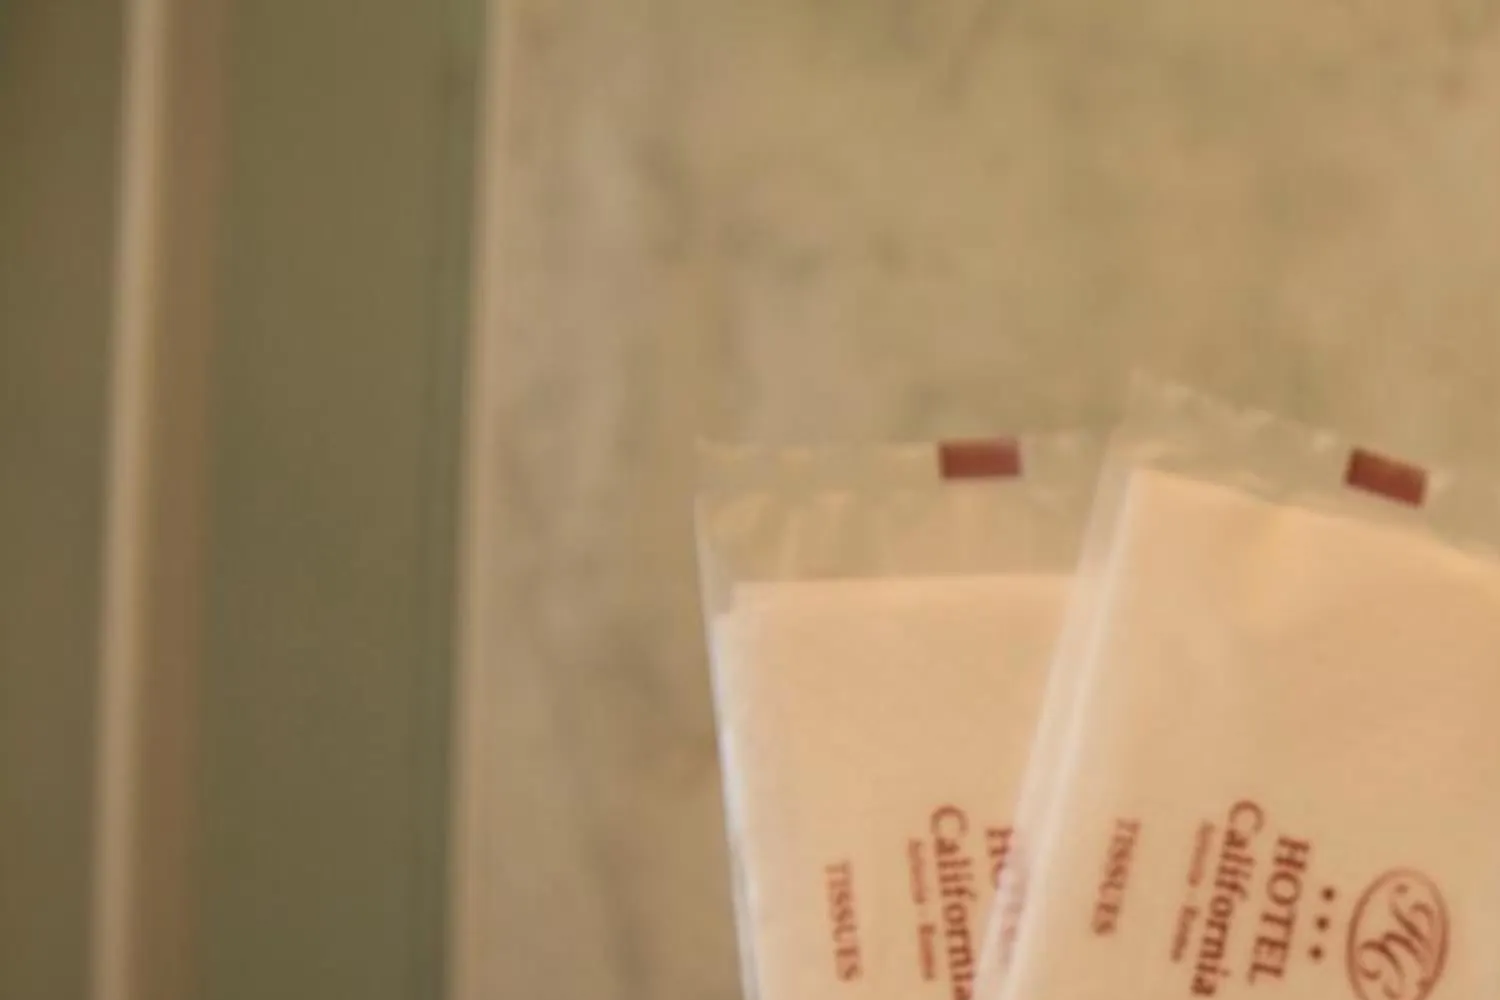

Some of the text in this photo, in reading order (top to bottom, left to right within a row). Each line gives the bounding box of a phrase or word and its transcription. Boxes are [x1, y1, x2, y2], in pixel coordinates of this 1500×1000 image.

[1091, 817, 1142, 937] TISSUES
[1191, 799, 1265, 998] California
[1246, 835, 1311, 985] HOTEL
